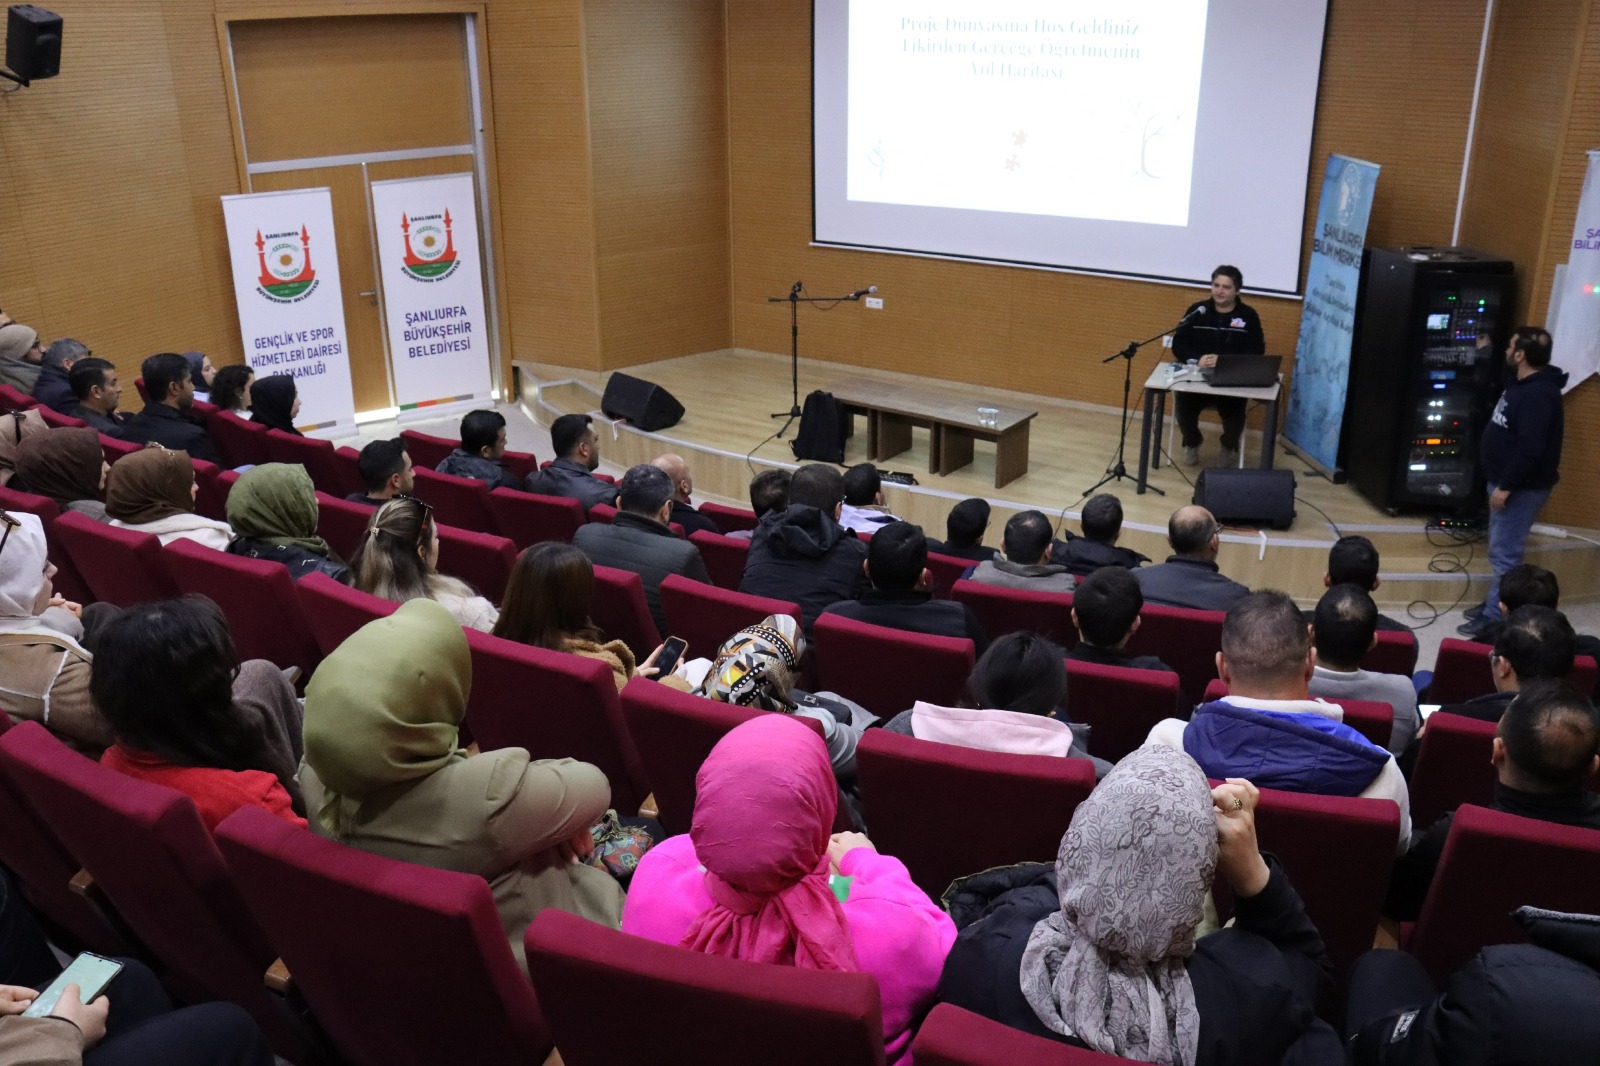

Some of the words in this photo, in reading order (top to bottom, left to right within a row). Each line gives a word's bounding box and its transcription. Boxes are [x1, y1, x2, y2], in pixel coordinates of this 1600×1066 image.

[900, 15, 941, 33] Proje
[1069, 18, 1141, 36] Geldiniz
[405, 305, 467, 327] ŞANLIURFA
[254, 331, 295, 349] GENÇLİK
[296, 330, 308, 343] VE
[310, 326, 335, 341] SPOR
[403, 320, 472, 342] BÜYÜKŞEHİR
[251, 346, 305, 368] HİZMETLERİ
[307, 340, 342, 359] DAİRESİ
[408, 336, 471, 358] BELEDİYESİ
